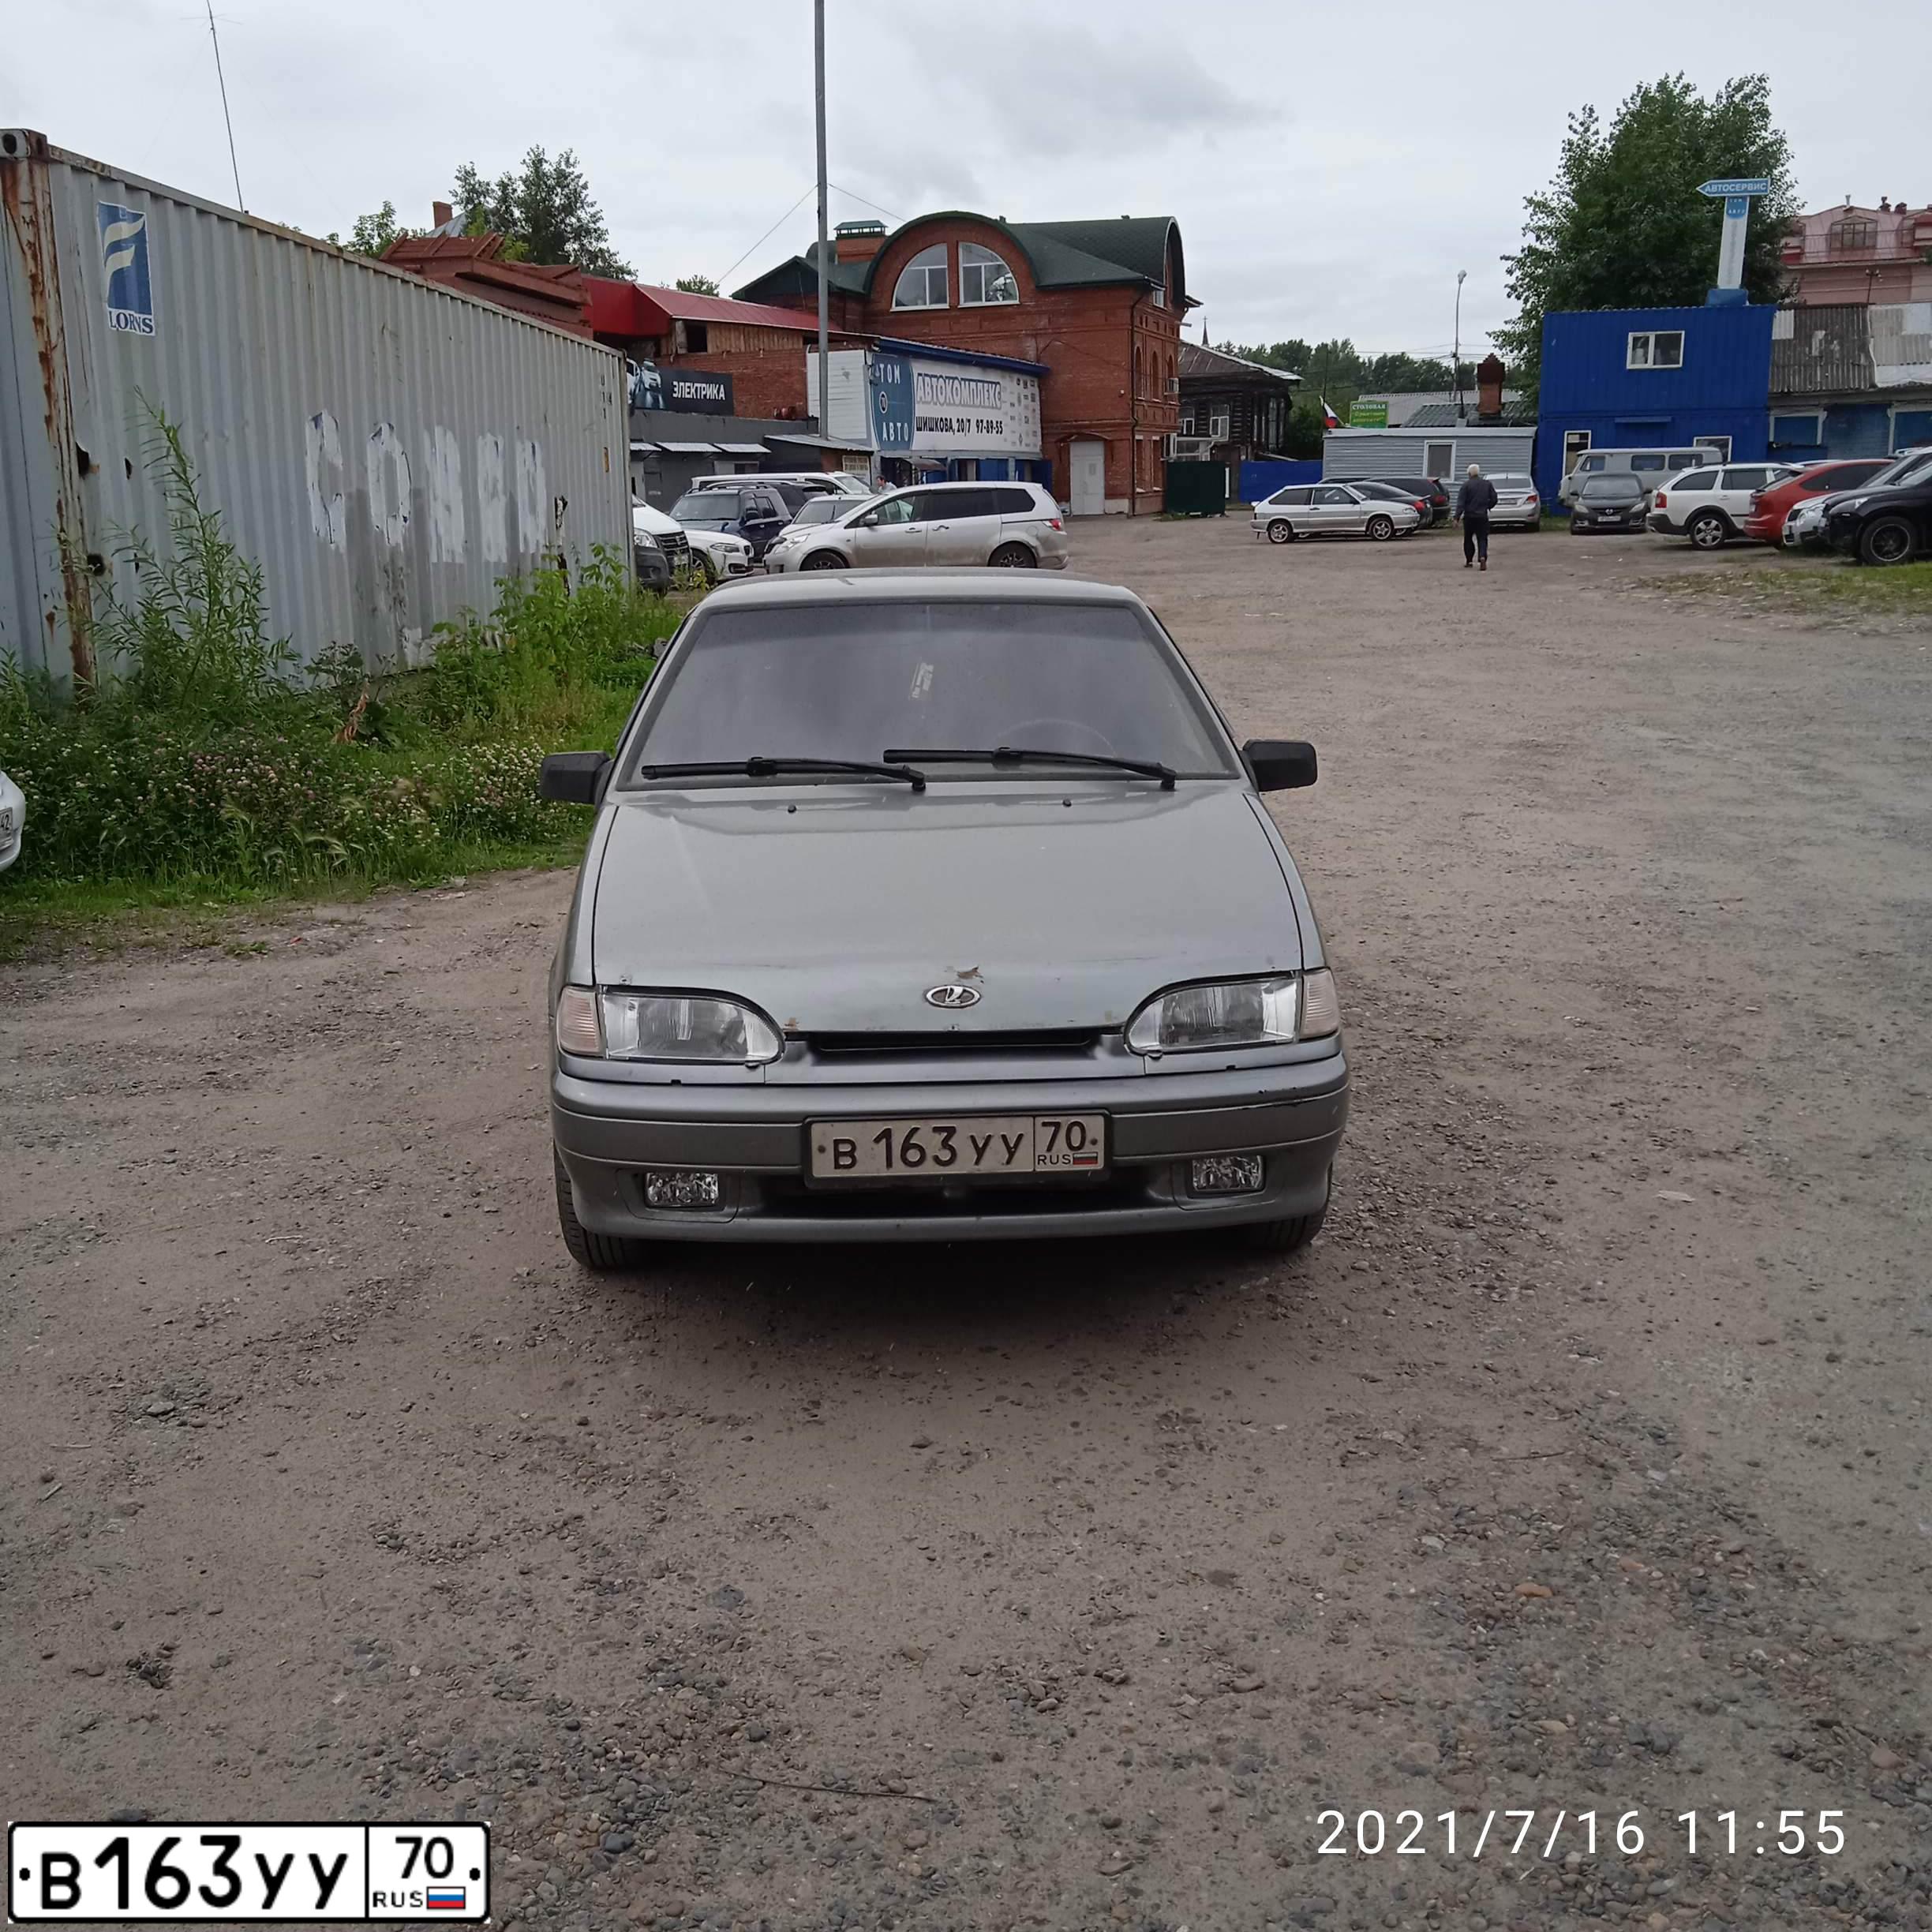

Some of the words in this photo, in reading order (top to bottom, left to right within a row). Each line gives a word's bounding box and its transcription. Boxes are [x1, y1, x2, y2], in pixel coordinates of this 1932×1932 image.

[1705, 182, 1767, 192] АВТОСЕРВИС
[879, 364, 900, 384] ТОМ
[672, 380, 725, 400] ЭЛЕКТРИКА
[916, 373, 1002, 410] АВТОКОМПЛЕКС
[882, 421, 909, 441] АВТО
[915, 416, 955, 436] ШИШКОВА,
[956, 417, 972, 437] 20/7
[975, 419, 1003, 435] 97-89-55
[1041, 1121, 1087, 1152] 70
[1037, 1154, 1072, 1166] RUS
